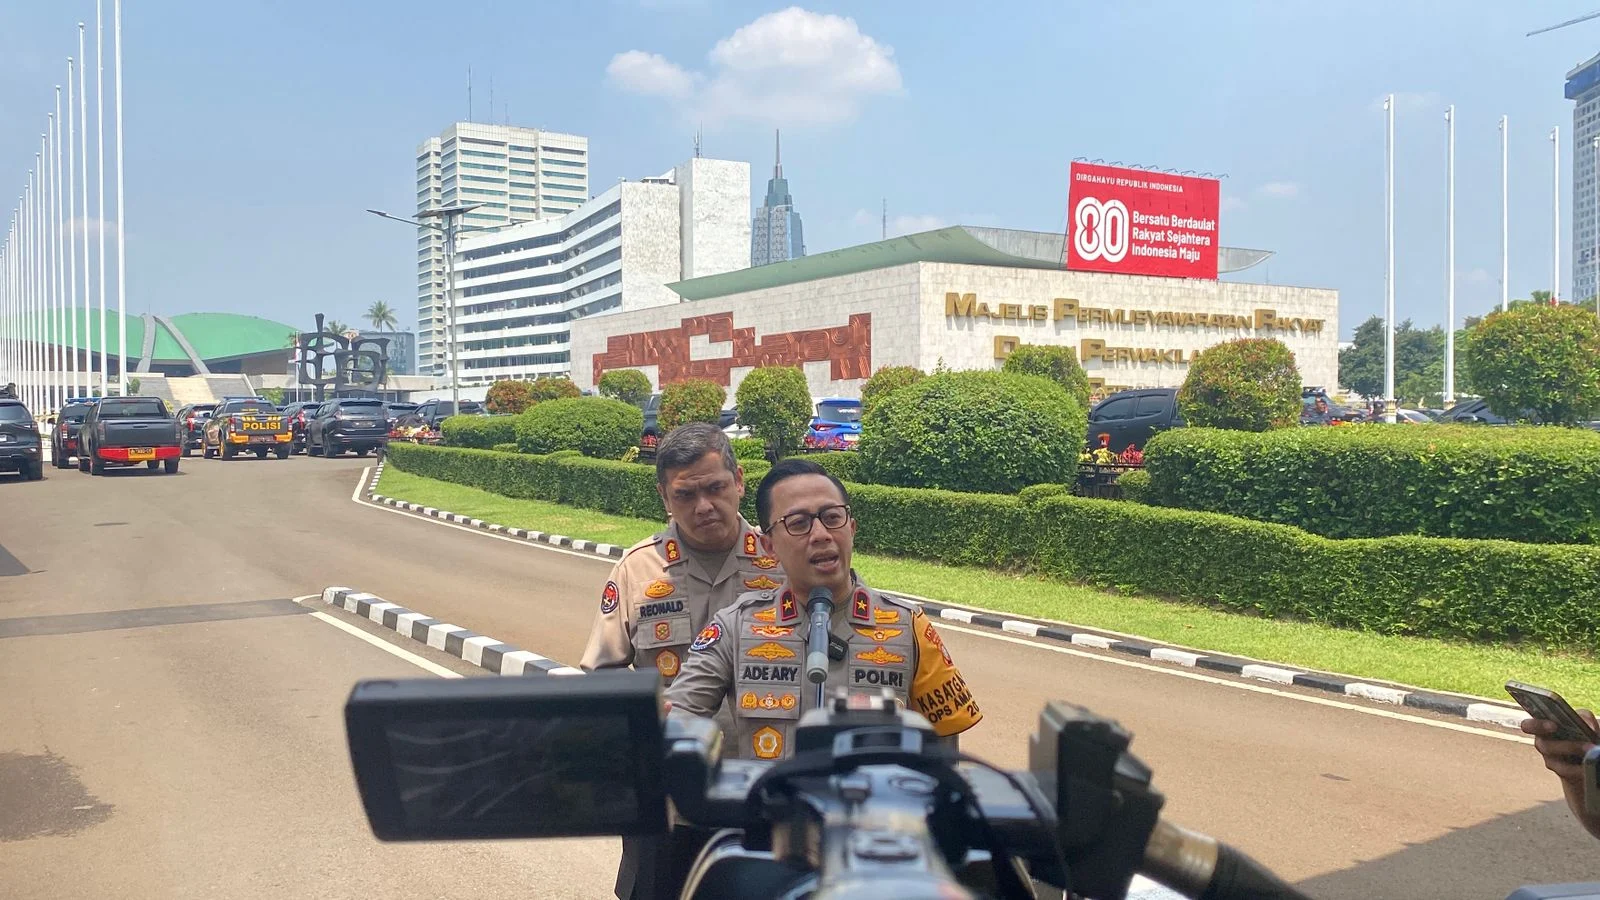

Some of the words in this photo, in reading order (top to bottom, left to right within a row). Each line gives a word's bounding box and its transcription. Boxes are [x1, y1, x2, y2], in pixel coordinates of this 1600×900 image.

[1076, 173, 1115, 185] DIRGAHAYU
[1116, 179, 1148, 189] REPUBLIK
[1150, 183, 1184, 193] INDONESIA
[1074, 197, 1129, 263] 80
[1132, 211, 1170, 225] Bersatu
[1171, 214, 1216, 231] Berdaulat
[1132, 226, 1166, 243] Rakyat
[1167, 230, 1211, 247] Sejahtera
[1132, 244, 1177, 258] Indonesia
[1179, 247, 1201, 264] Maju
[945, 292, 1048, 320] MAJELIS
[1053, 298, 1252, 330] PERMUSYAWARATAN
[1254, 308, 1326, 332] RAKYAT
[242, 421, 281, 431] POLISI
[640, 600, 684, 618] REONALD
[743, 667, 770, 682] ADE
[770, 667, 798, 682] ARY
[854, 669, 904, 687] POLRI
[928, 705, 952, 723] OPS
